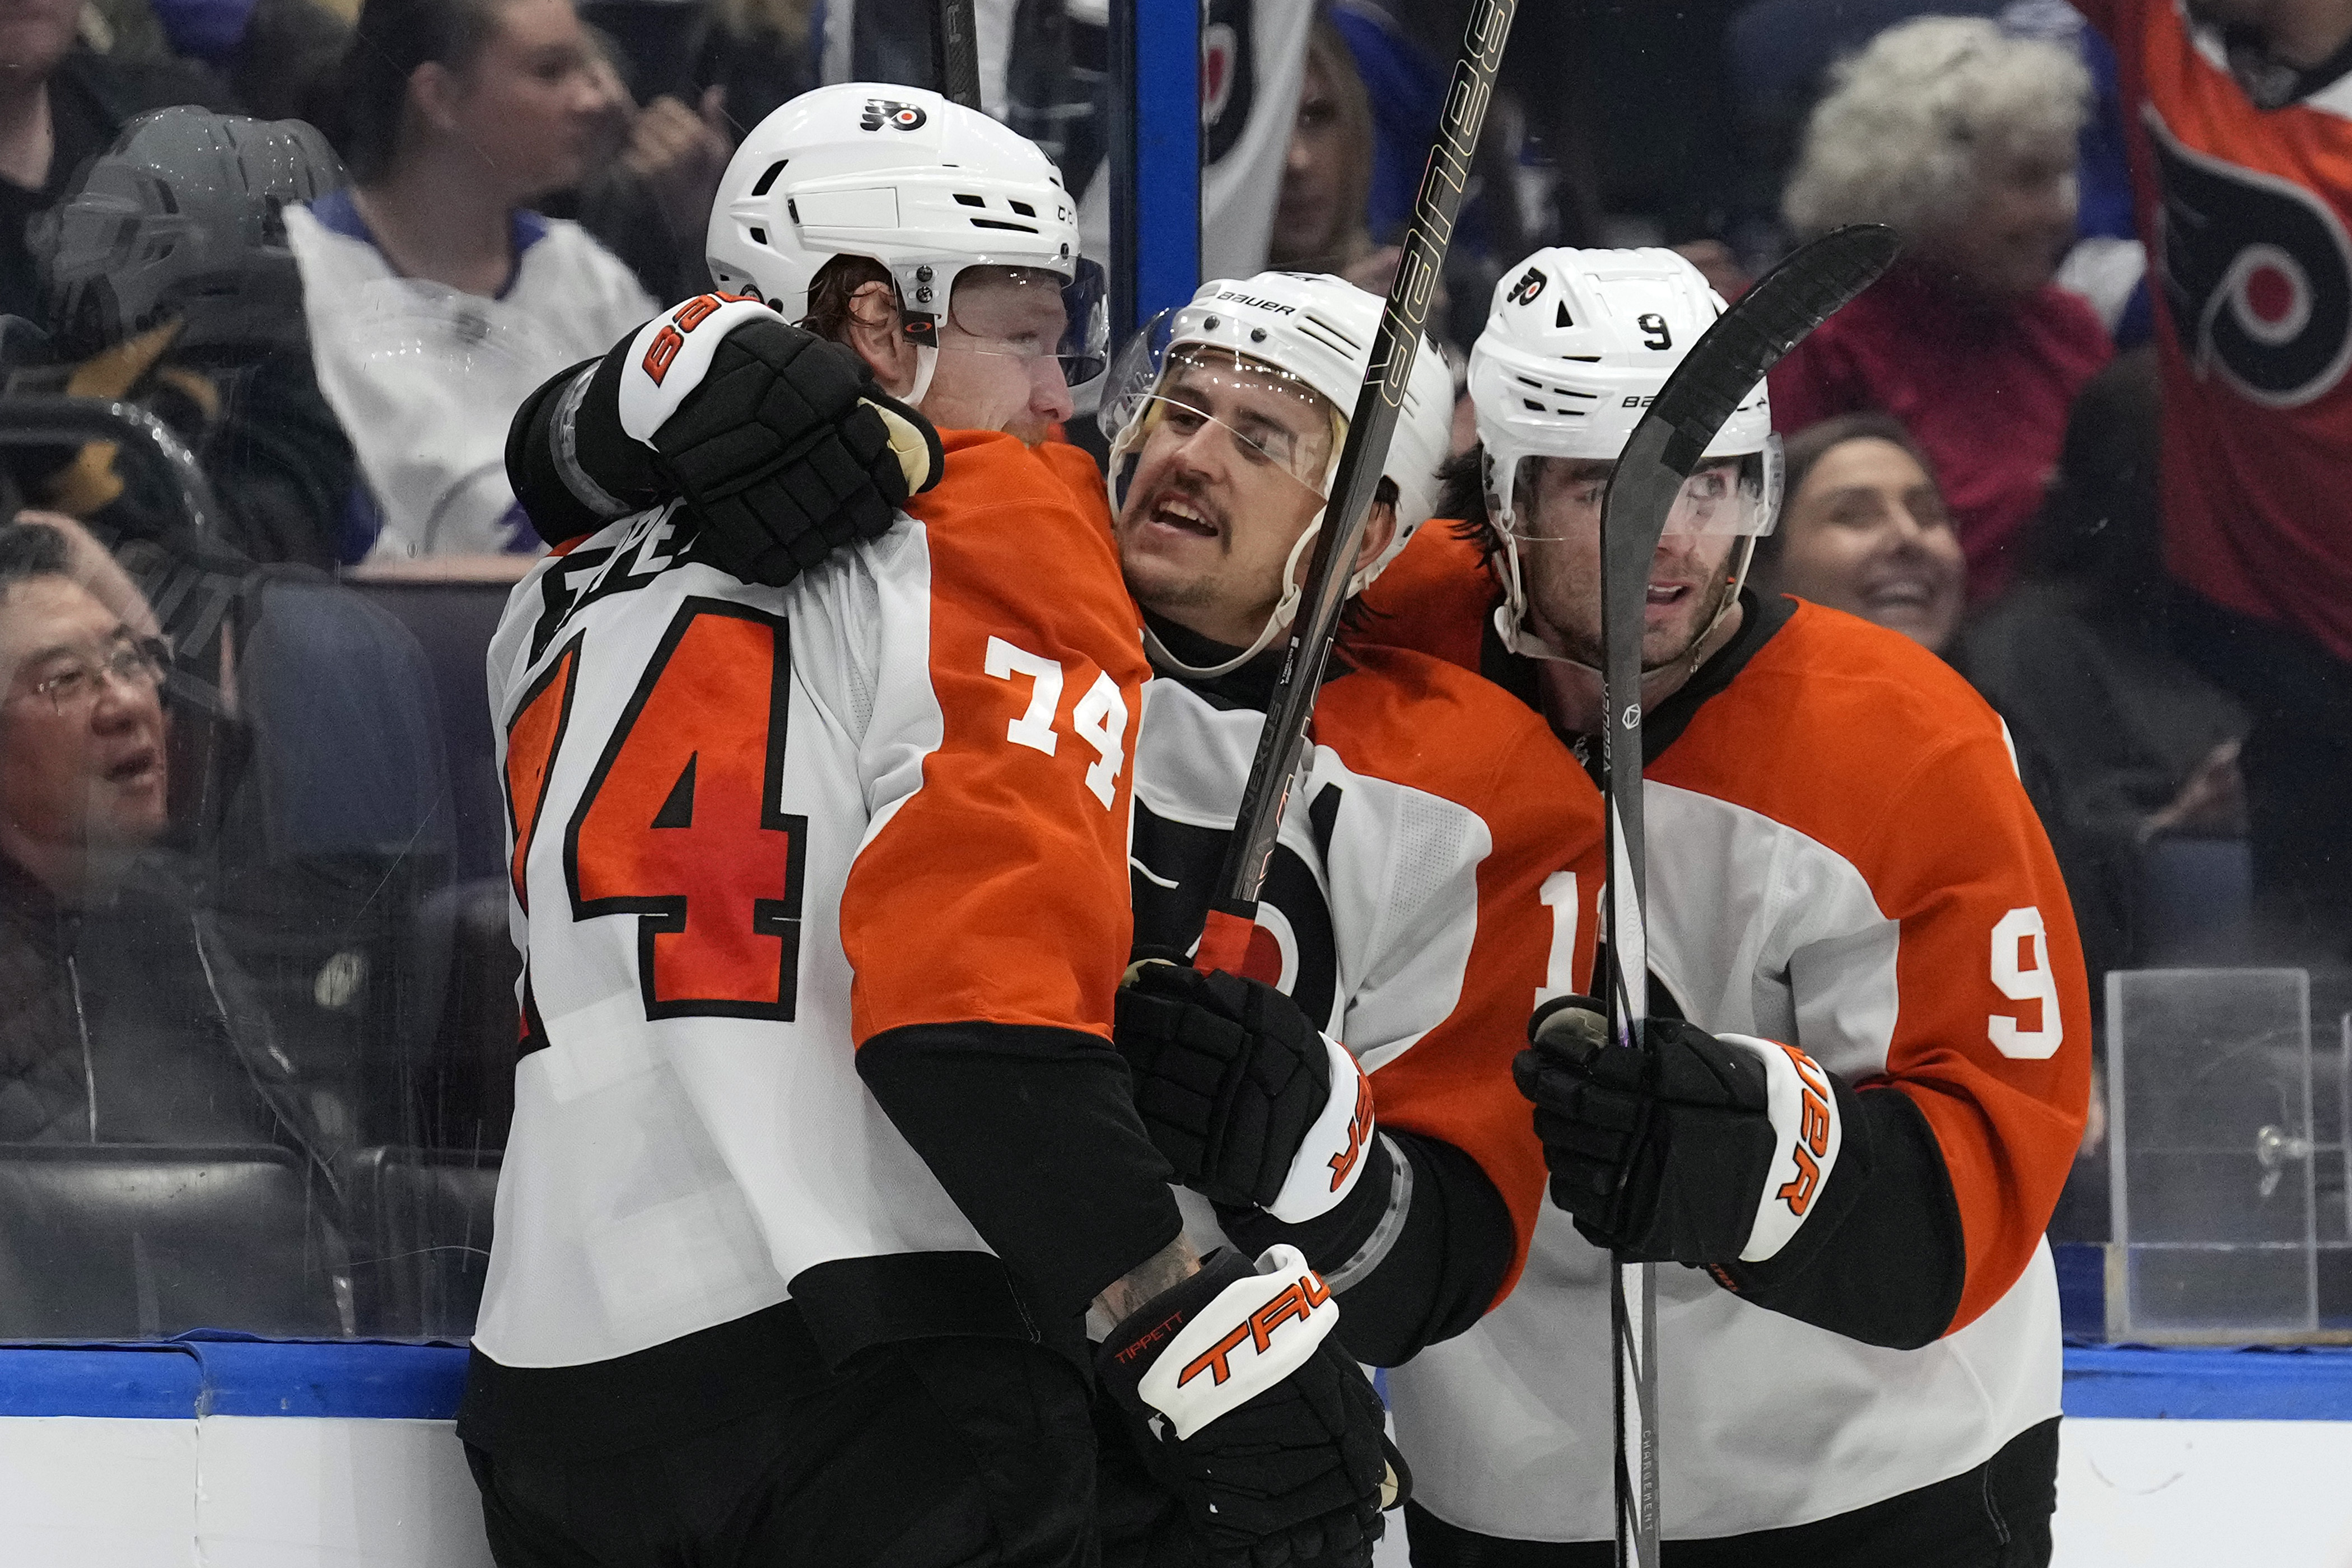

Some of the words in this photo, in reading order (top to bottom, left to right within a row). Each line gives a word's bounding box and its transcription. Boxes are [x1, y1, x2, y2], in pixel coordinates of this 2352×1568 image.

[1637, 313, 1672, 351] 9
[984, 635, 1128, 811] 74
[1533, 870, 1606, 1011] 1
[1988, 906, 2064, 1060] 9
[1114, 1311, 1184, 1365] TIPPETT
